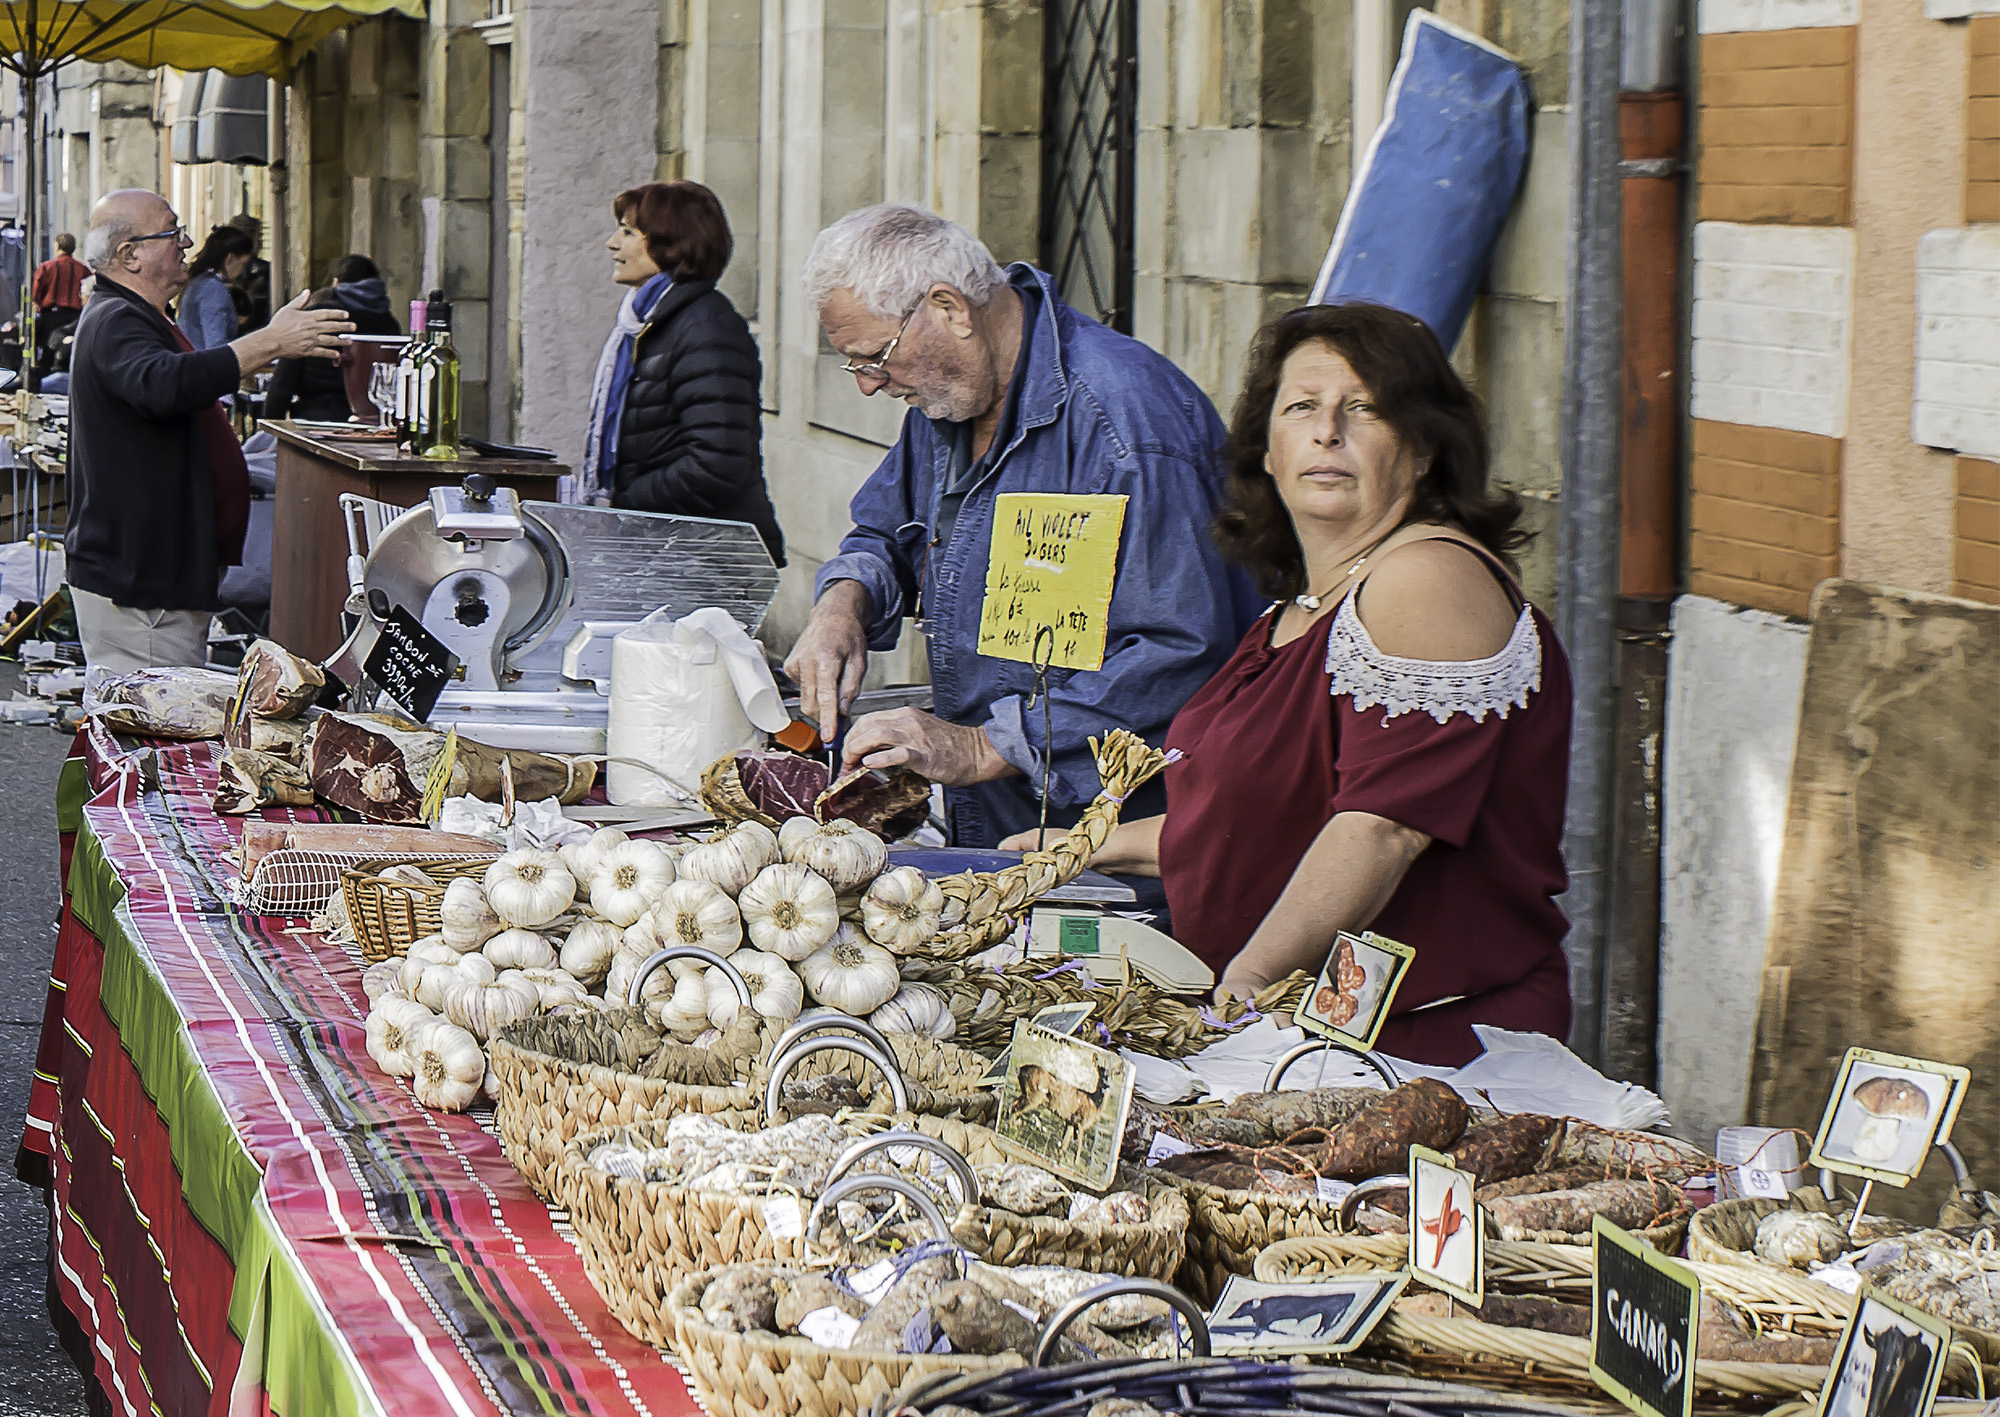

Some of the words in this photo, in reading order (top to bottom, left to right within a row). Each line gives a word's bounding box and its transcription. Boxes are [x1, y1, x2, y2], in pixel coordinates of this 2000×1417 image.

[1014, 508, 1033, 538] AIL
[1042, 512, 1091, 540] VIOLET
[385, 622, 429, 662] JAMBON
[389, 646, 423, 679] COCHE
[1606, 1287, 1684, 1394] CANARD
